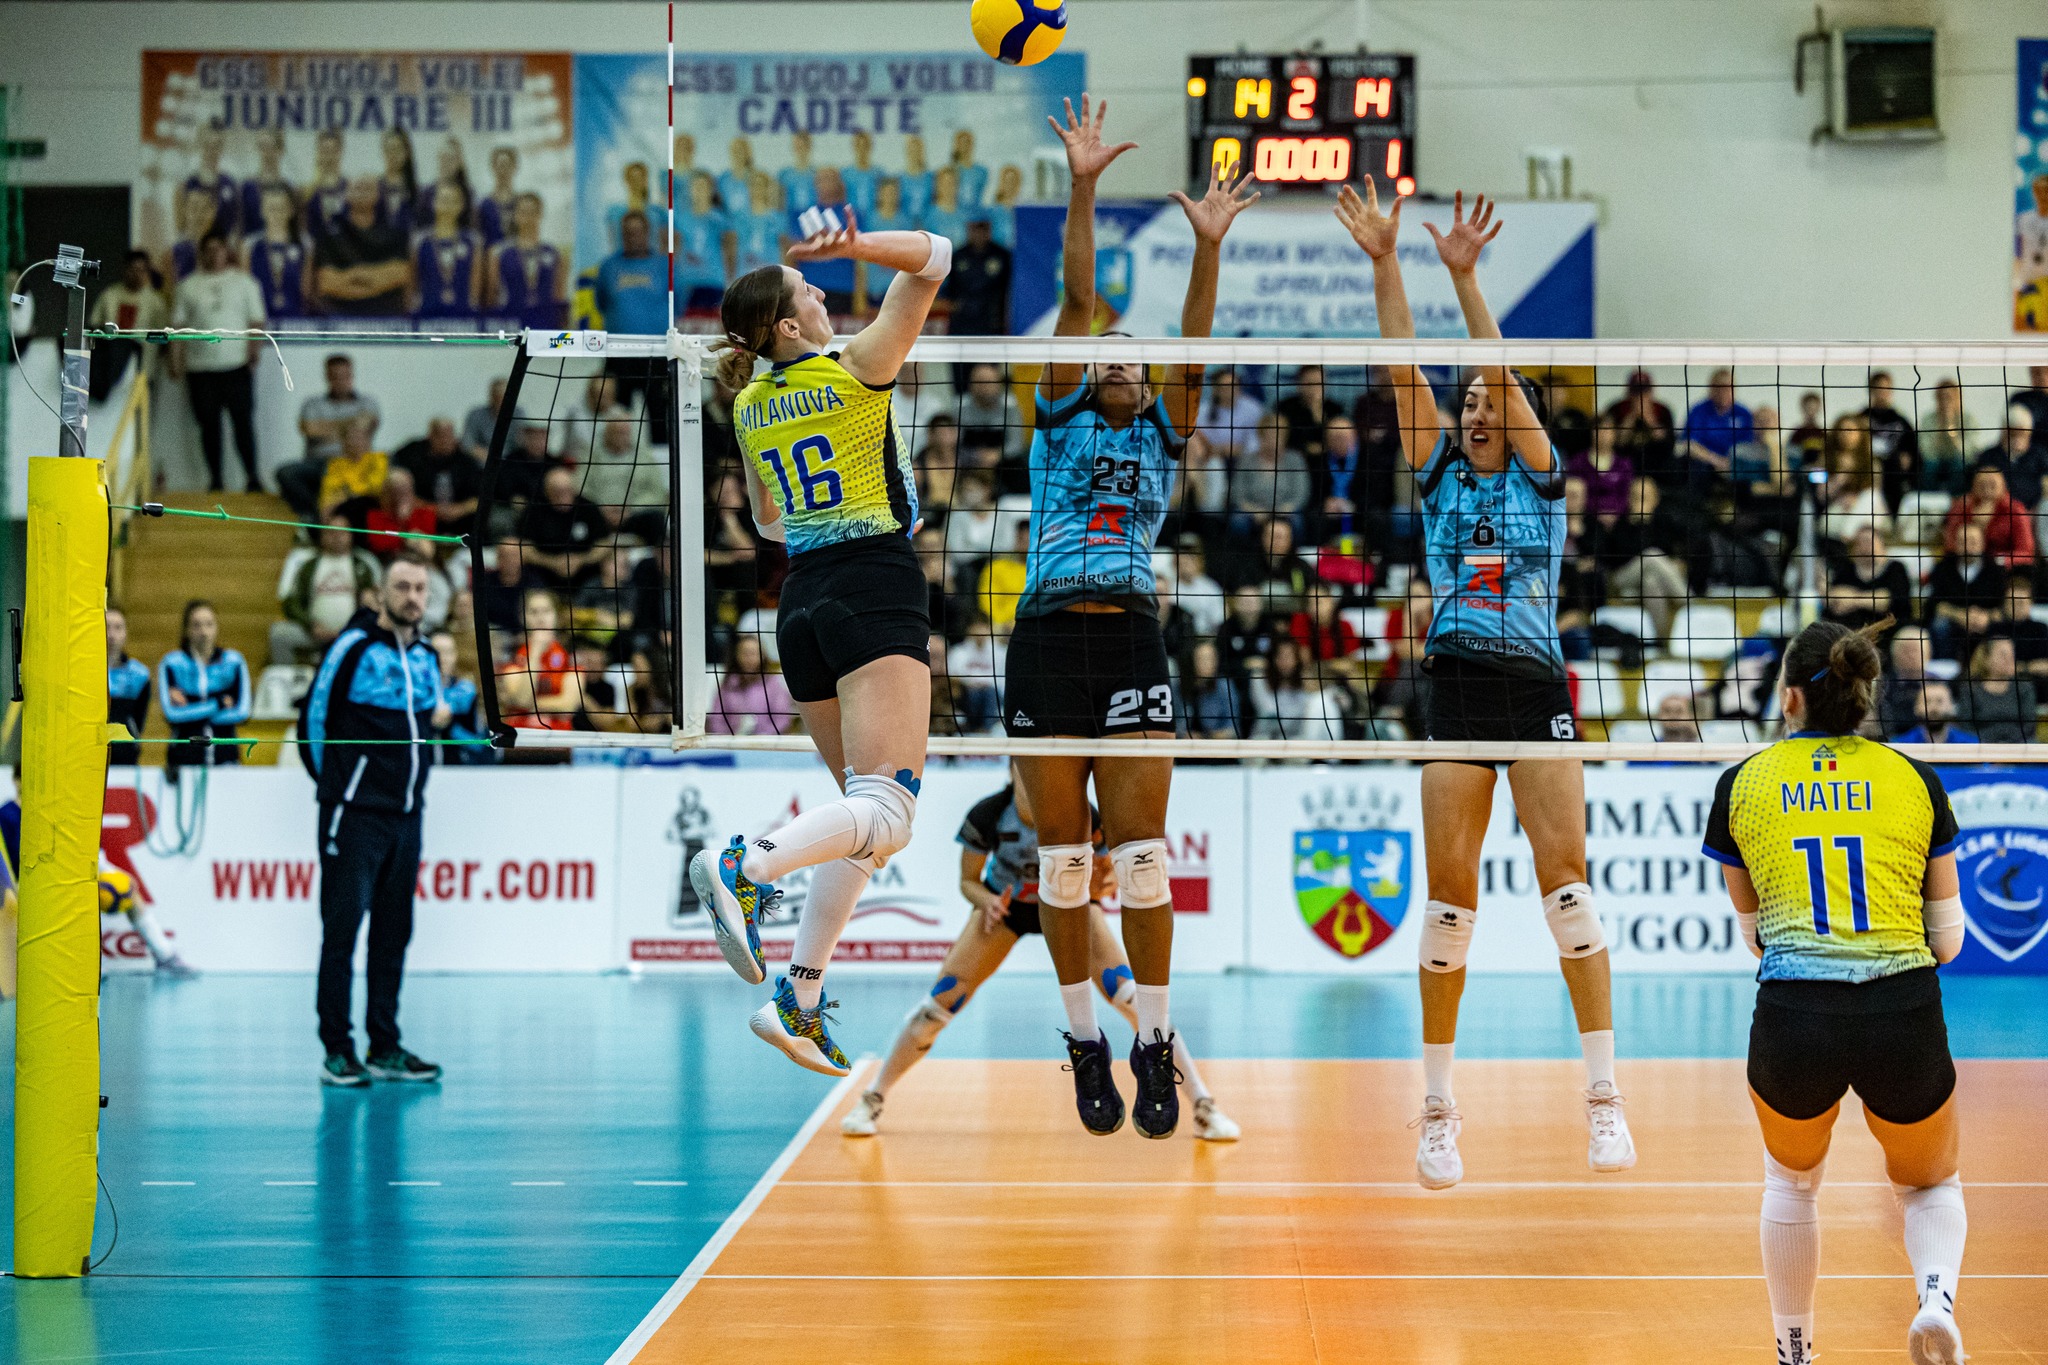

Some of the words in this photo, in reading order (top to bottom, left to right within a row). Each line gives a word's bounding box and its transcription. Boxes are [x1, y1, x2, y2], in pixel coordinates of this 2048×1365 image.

[210, 92, 449, 132] JUNIOARE
[737, 98, 922, 135] CADETE
[1287, 76, 1317, 121] 2
[1253, 136, 1351, 182] 0000
[741, 385, 845, 432] MILANOVA
[760, 434, 844, 516] 16
[1091, 455, 1140, 496] 23
[1472, 515, 1496, 548] 6
[1043, 571, 1111, 590] PRIMĂRIA
[1113, 573, 1149, 590] LUGOJ
[1105, 684, 1173, 727] 23
[1550, 713, 1575, 740] 6
[1781, 780, 1872, 814] MATEI
[1792, 836, 1870, 936] 11
